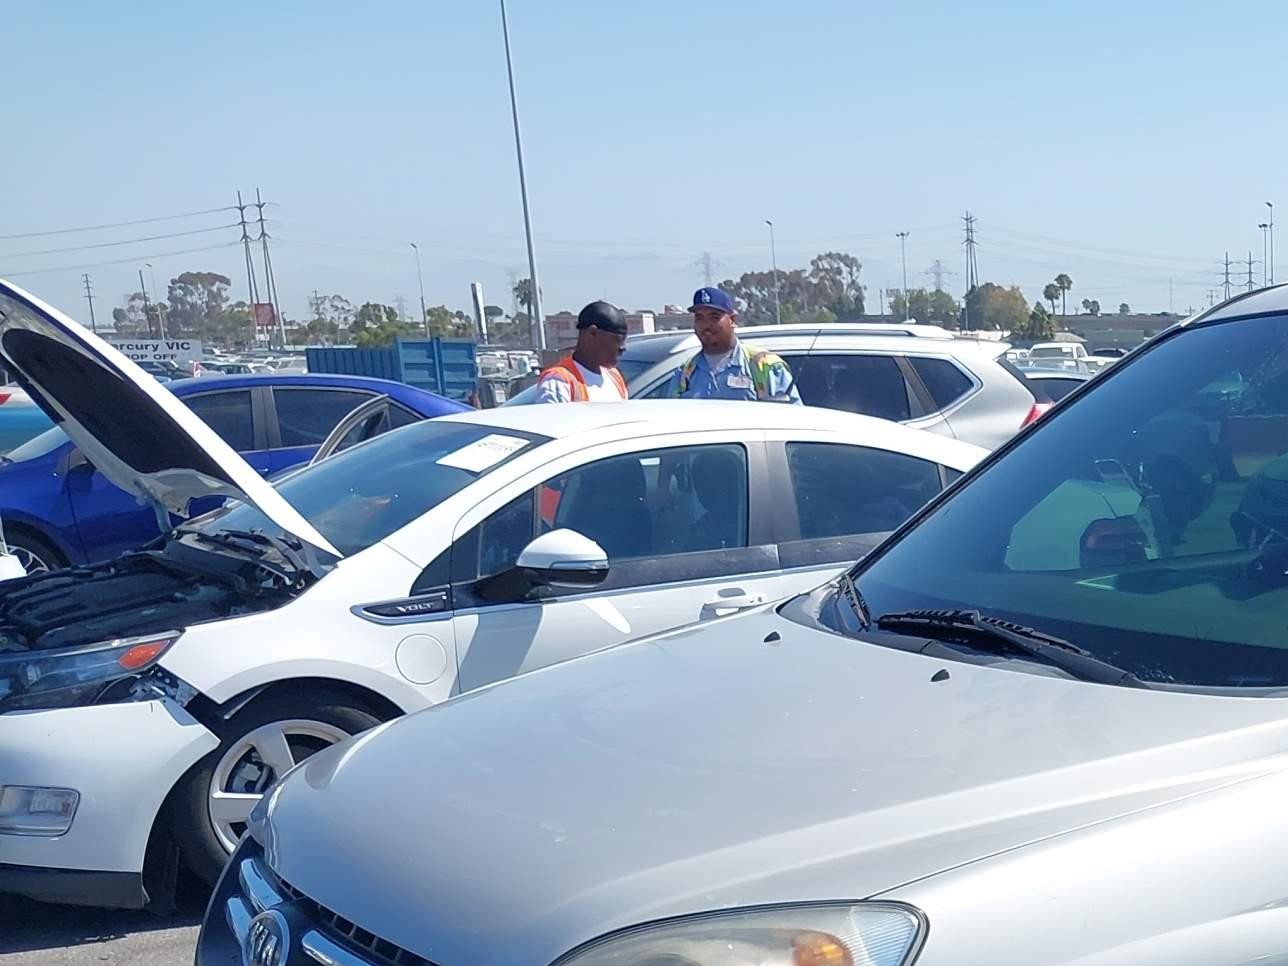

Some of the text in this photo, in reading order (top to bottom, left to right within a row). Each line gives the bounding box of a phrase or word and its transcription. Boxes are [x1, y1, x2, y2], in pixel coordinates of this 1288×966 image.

[111, 342, 191, 352] ercury VIC
[396, 602, 434, 612] VOLT
